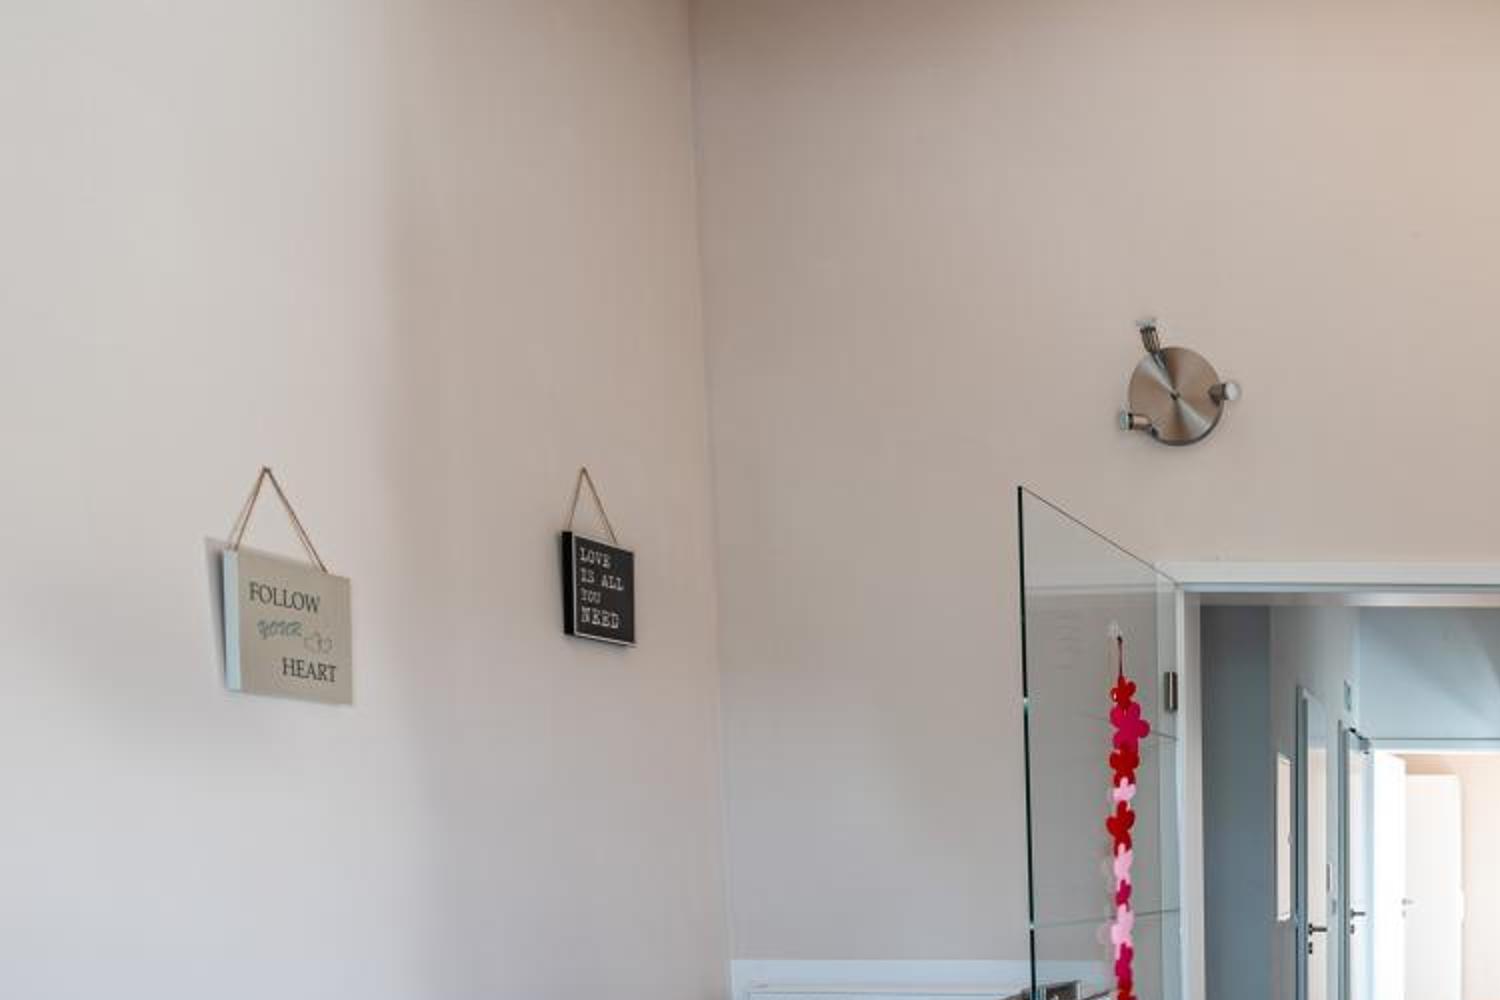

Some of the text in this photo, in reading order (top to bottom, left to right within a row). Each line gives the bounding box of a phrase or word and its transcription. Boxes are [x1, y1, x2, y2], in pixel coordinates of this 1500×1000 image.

[580, 547, 611, 569] LOVE
[581, 567, 624, 591] IS ALL
[249, 580, 321, 614] FOLLOW
[581, 587, 601, 604] YOU
[581, 606, 620, 629] NEED
[281, 656, 337, 683] HEART
